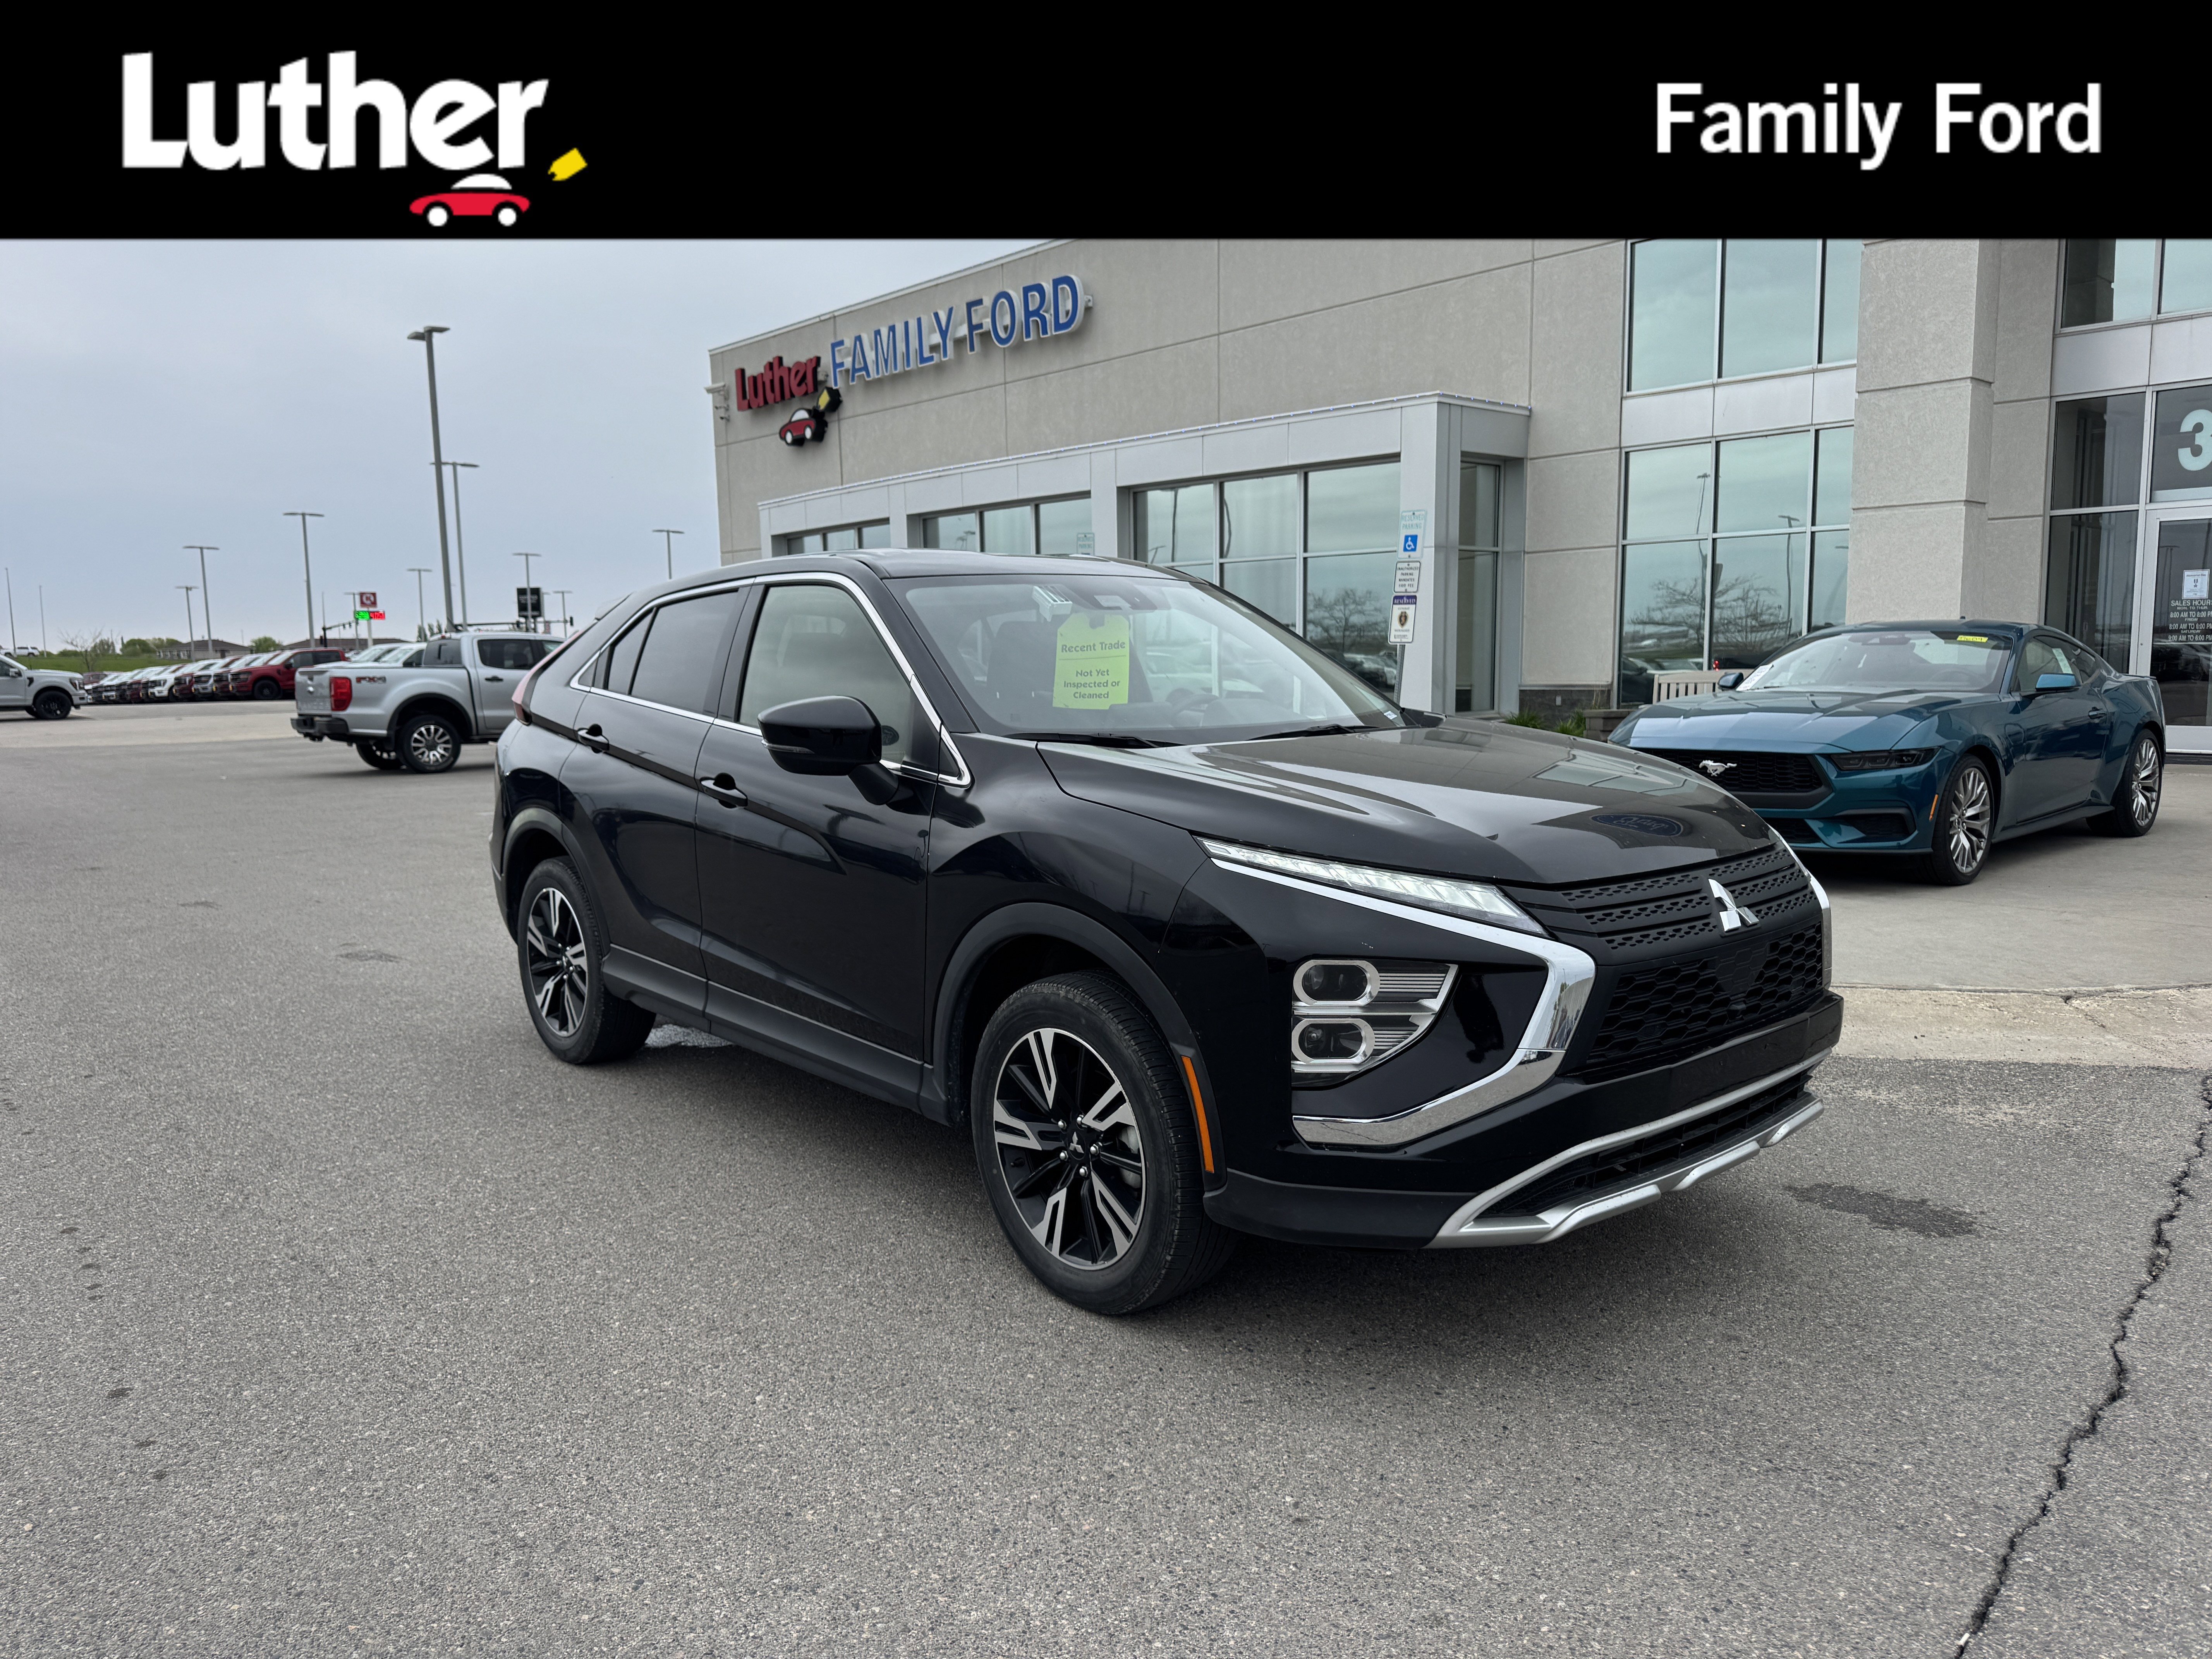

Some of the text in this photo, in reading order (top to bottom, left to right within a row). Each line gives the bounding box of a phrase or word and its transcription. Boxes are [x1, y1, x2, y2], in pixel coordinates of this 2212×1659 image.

[830, 274, 1084, 389] FAMILY FORD
[735, 355, 821, 412] Luther
[1061, 640, 1126, 653] Recent Trade
[1063, 680, 1108, 689] Inspected
